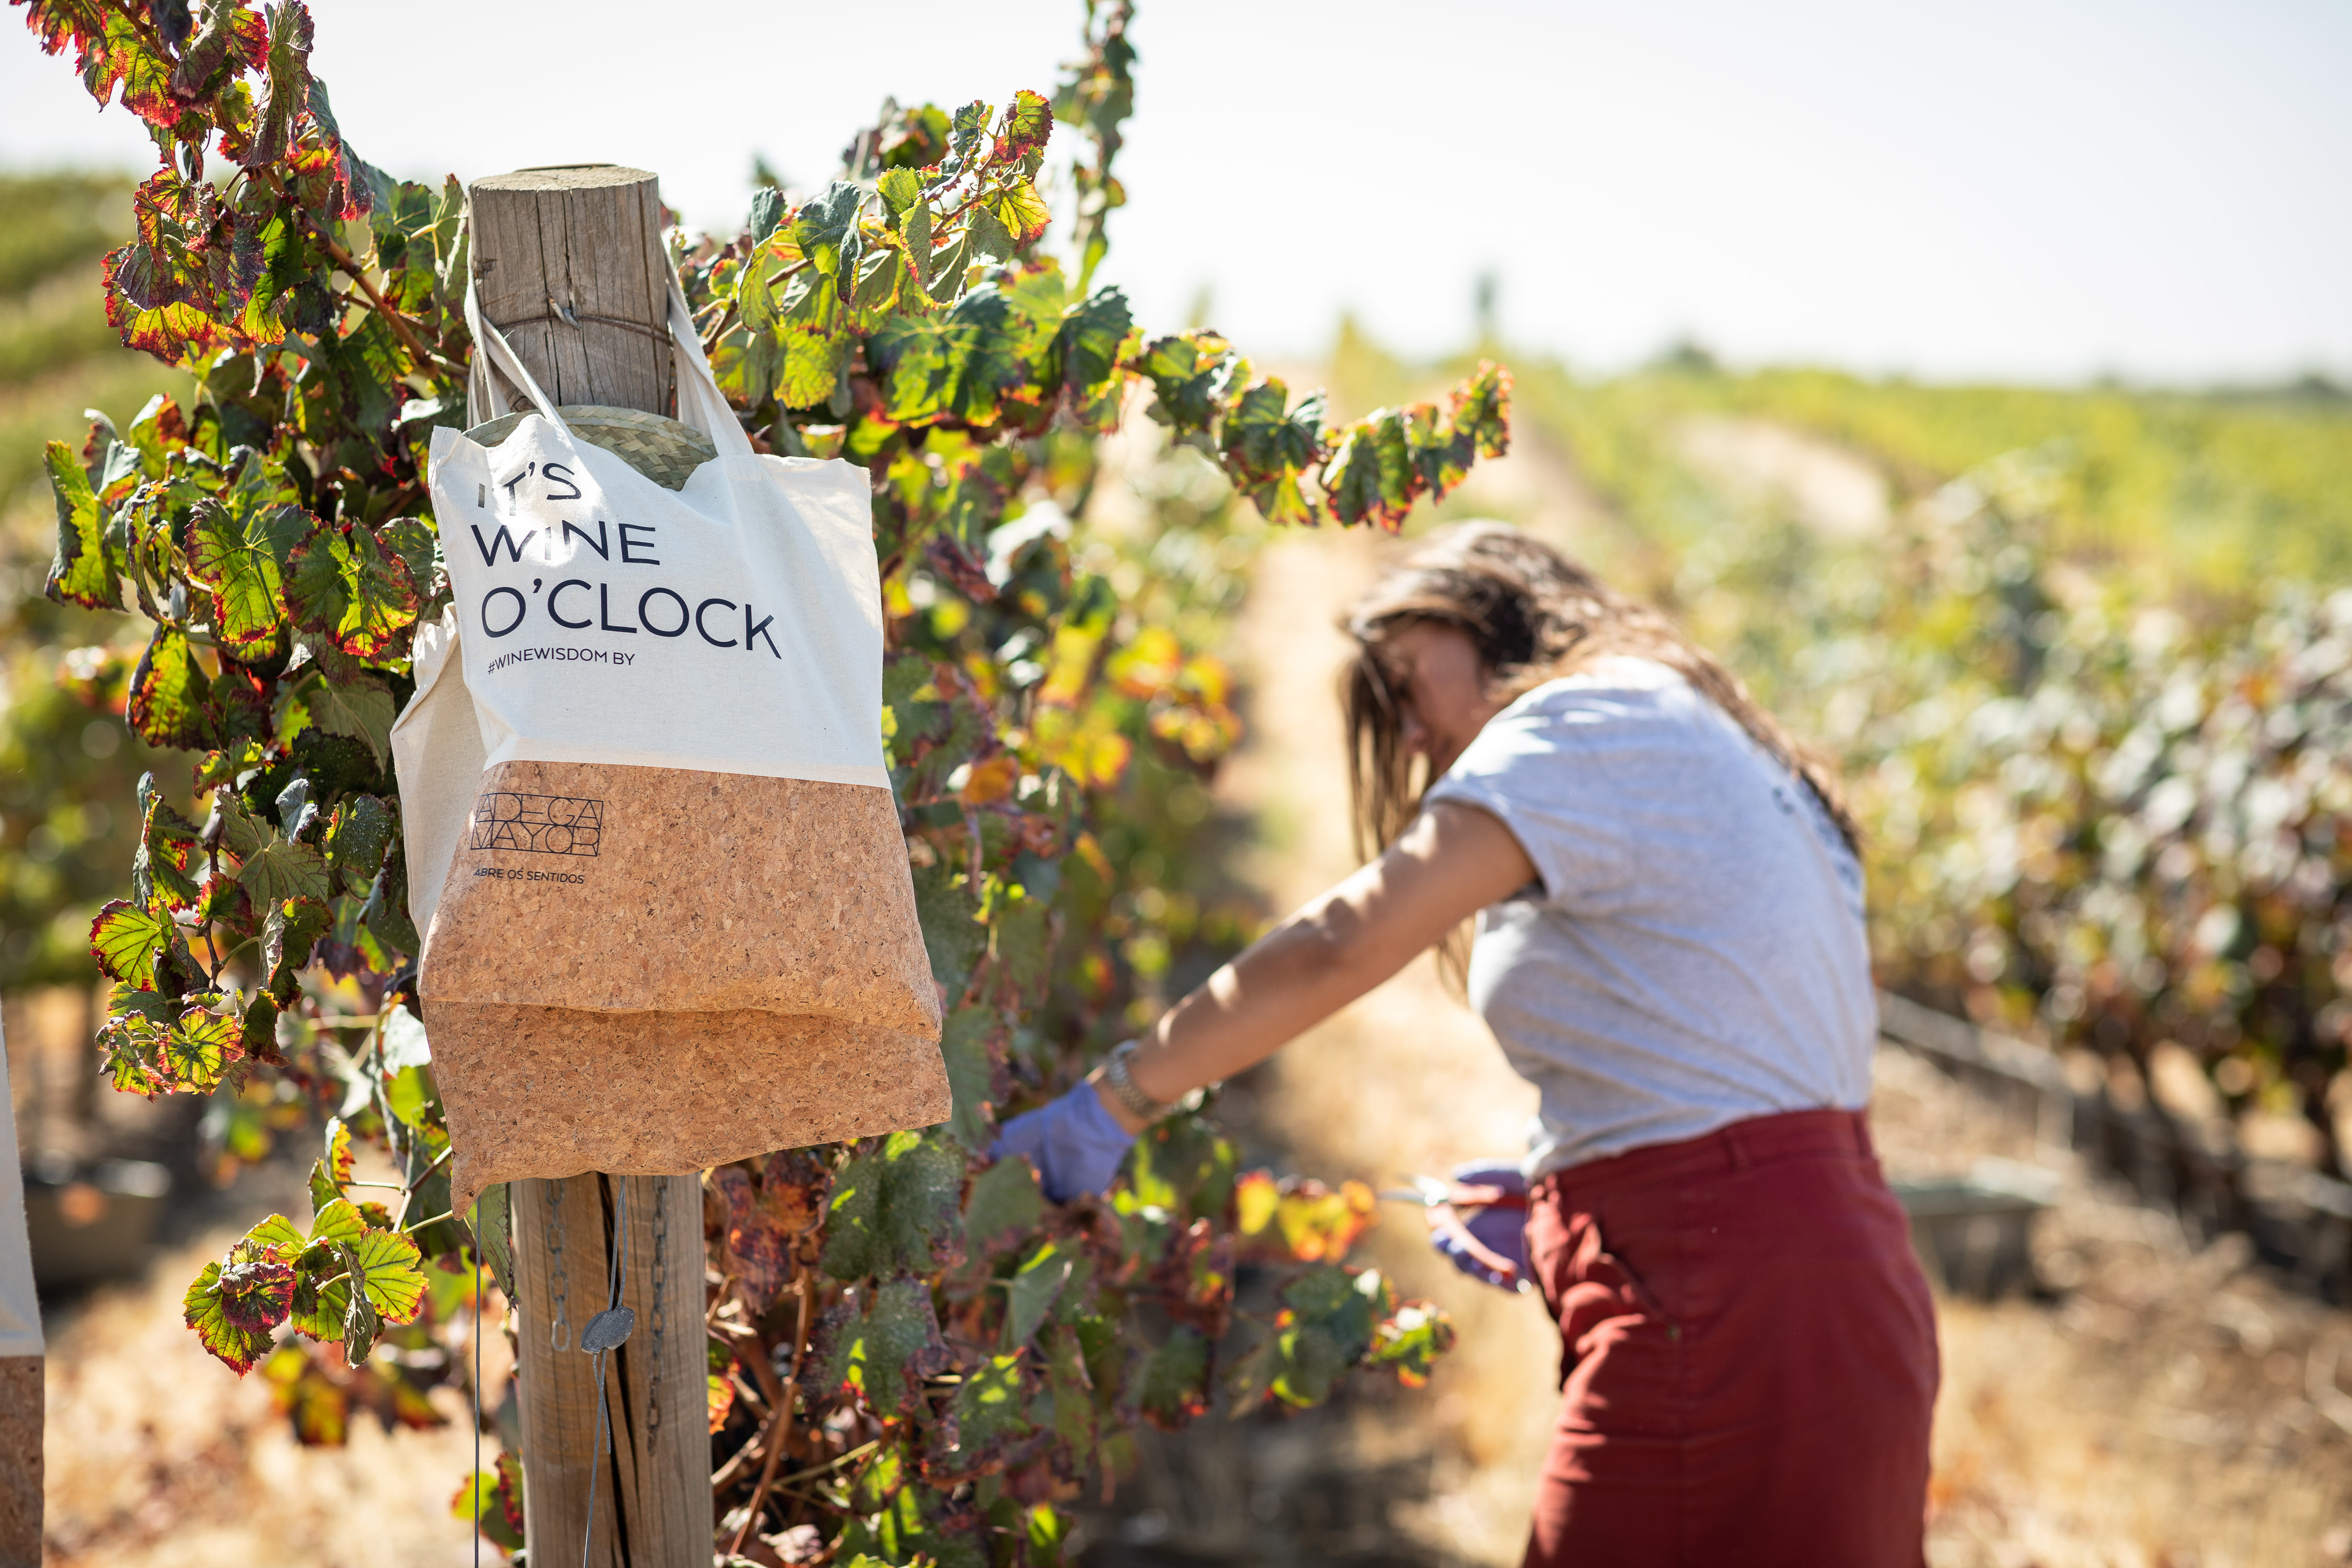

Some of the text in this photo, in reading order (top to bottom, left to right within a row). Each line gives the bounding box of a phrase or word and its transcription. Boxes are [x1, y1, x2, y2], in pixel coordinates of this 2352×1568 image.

[478, 462, 582, 516] IT'S
[470, 520, 660, 567] WINE
[482, 579, 782, 660] O'CLOCK
[488, 648, 635, 675] #WINEWISDOM BY
[476, 793, 604, 829] ADEGA
[471, 820, 601, 857] MAYOR
[474, 868, 585, 884] ABRE OS SENTIDOS
